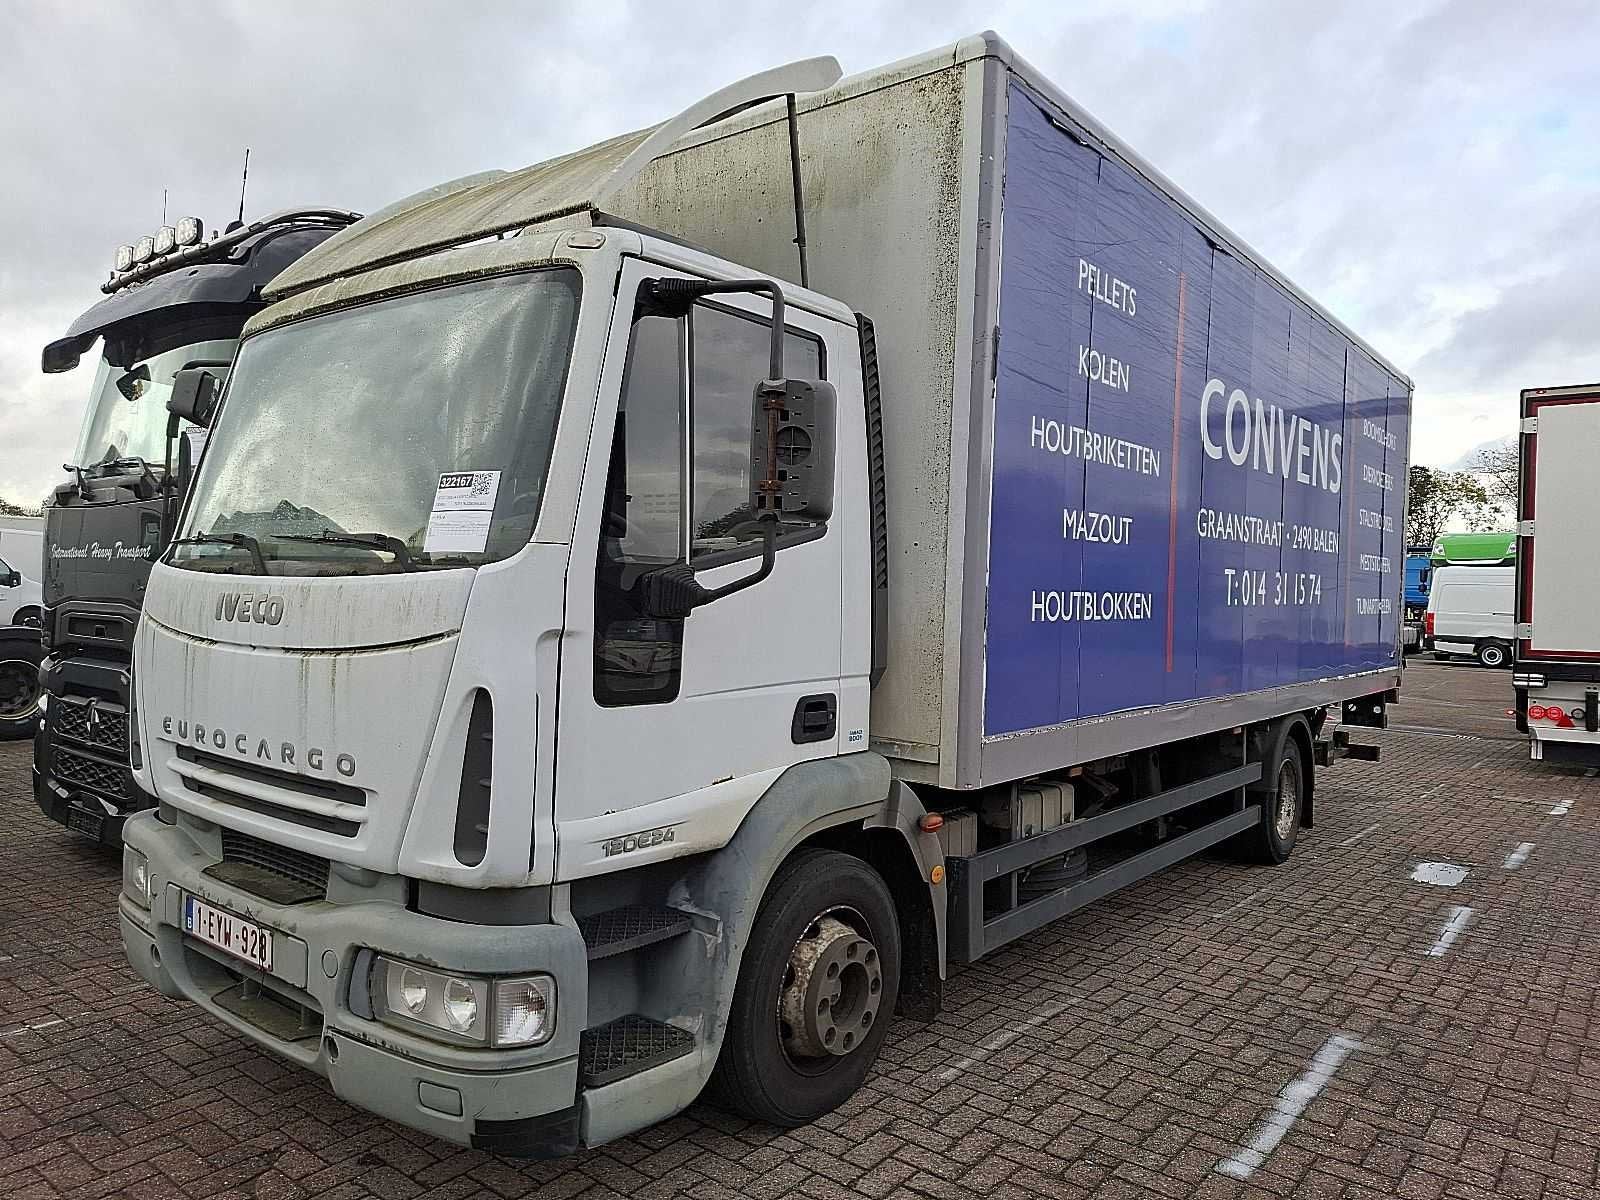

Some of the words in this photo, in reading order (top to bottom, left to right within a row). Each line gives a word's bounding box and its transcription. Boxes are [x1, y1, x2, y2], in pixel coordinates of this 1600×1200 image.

[1078, 258, 1137, 316] PELLETS
[1078, 345, 1130, 393] KOLEN
[1031, 415, 1161, 477] HOUTBRIKETTEN
[1200, 378, 1343, 494] CONVENS
[440, 476, 473, 488] 322167
[1063, 508, 1133, 545] MAZOUT
[1197, 507, 1285, 547] GRAANSTRAAT
[1293, 525, 1313, 550] 2490
[1314, 528, 1340, 554] BALEN
[51, 543, 89, 558] International
[91, 541, 113, 561] Heavy
[114, 540, 152, 562] Transport
[215, 591, 285, 626] IVECO
[1031, 590, 1153, 622] HOUTBLOKKEN
[162, 716, 357, 778] EUROCARGO
[602, 827, 675, 858] 120E24
